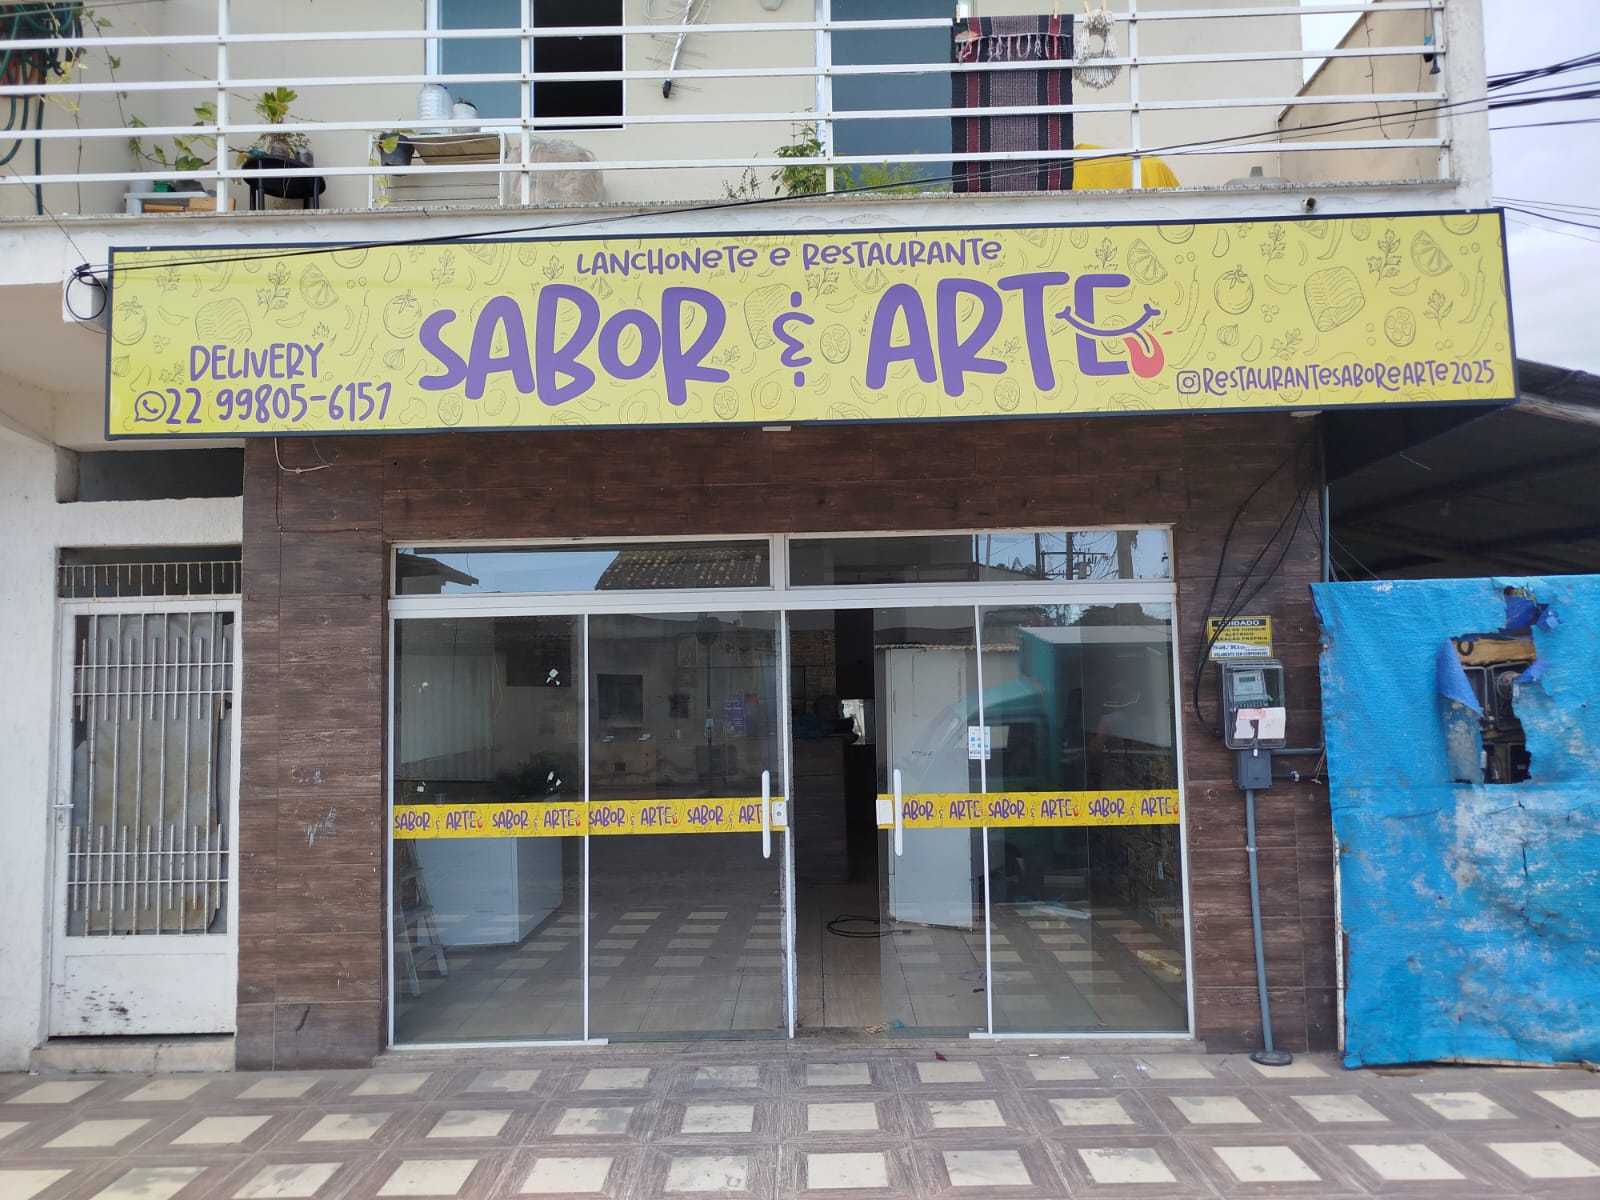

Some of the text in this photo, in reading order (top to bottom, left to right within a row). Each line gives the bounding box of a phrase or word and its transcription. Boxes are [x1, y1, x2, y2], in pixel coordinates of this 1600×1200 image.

[420, 271, 1140, 406] SABOR & ARTE
[190, 342, 324, 381] DELIVERY
[166, 382, 392, 424] 22 99805-6157
[394, 811, 430, 831] SABOR
[446, 810, 478, 831] ARTE
[492, 809, 528, 829] SABOR
[544, 808, 576, 829] ARTE
[588, 807, 625, 827] SABOR
[640, 806, 673, 826] ARTE
[687, 805, 723, 825] SABOR
[739, 804, 762, 825] ART
[902, 800, 934, 821] ABOR
[949, 800, 981, 820] ARTE
[988, 798, 1025, 820] SABOR
[1040, 798, 1073, 819] ARTE
[1088, 797, 1125, 818] SABOR
[1141, 796, 1173, 817] ARTE
